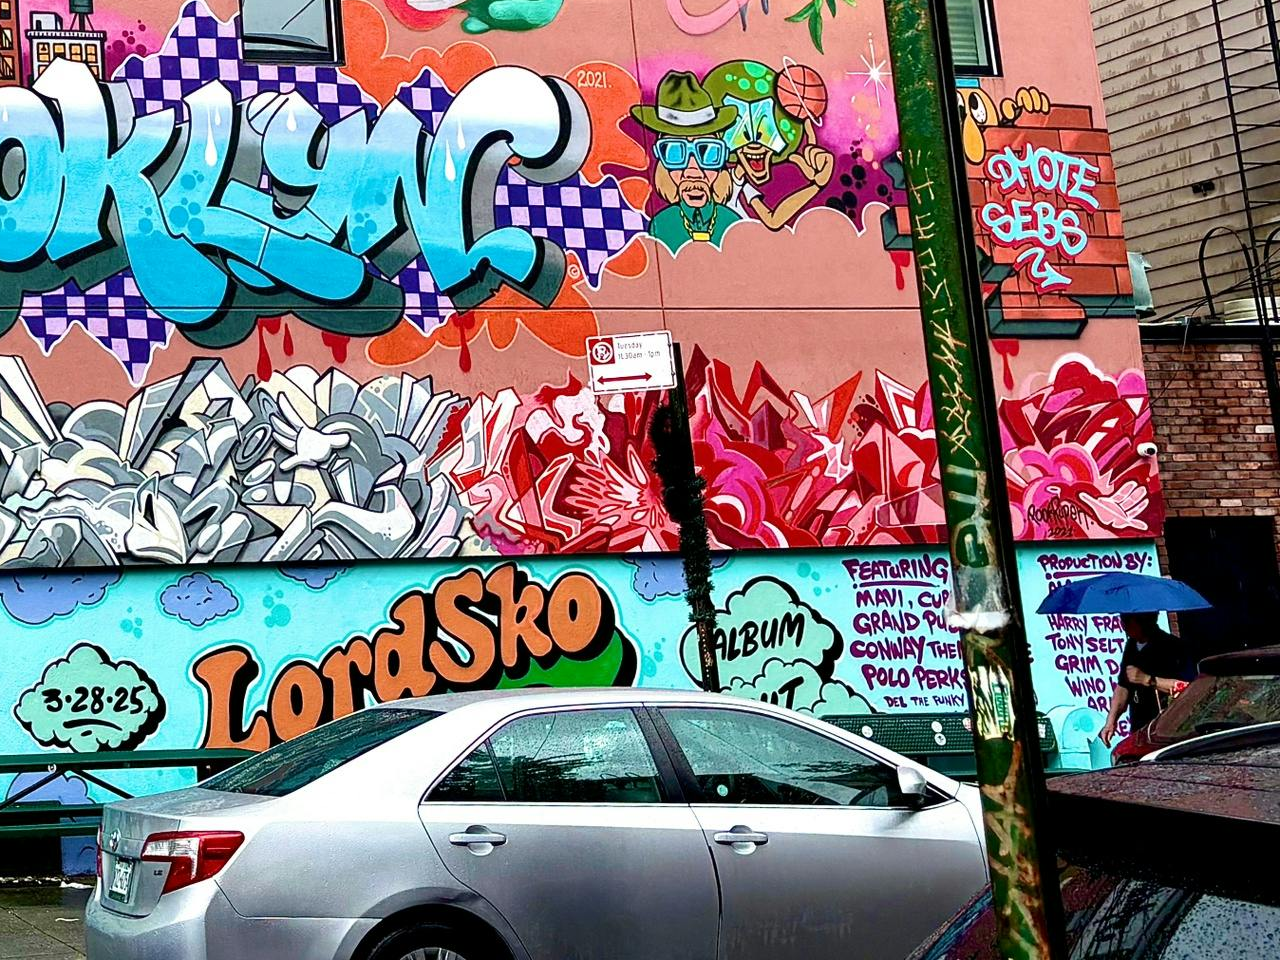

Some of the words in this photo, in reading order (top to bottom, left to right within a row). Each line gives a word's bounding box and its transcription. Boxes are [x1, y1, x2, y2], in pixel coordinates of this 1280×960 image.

[986, 144, 1100, 210] DMOTE
[980, 199, 1088, 256] SEBS
[853, 610, 921, 636] GRAND
[1047, 613, 1087, 636] HARRY
[712, 611, 806, 662] ALBUM
[850, 635, 926, 664] CONWAY
[1045, 632, 1083, 654] TONY
[861, 663, 910, 690] POLO
[1055, 654, 1103, 675] GRIM
[1065, 676, 1106, 697] WINO
